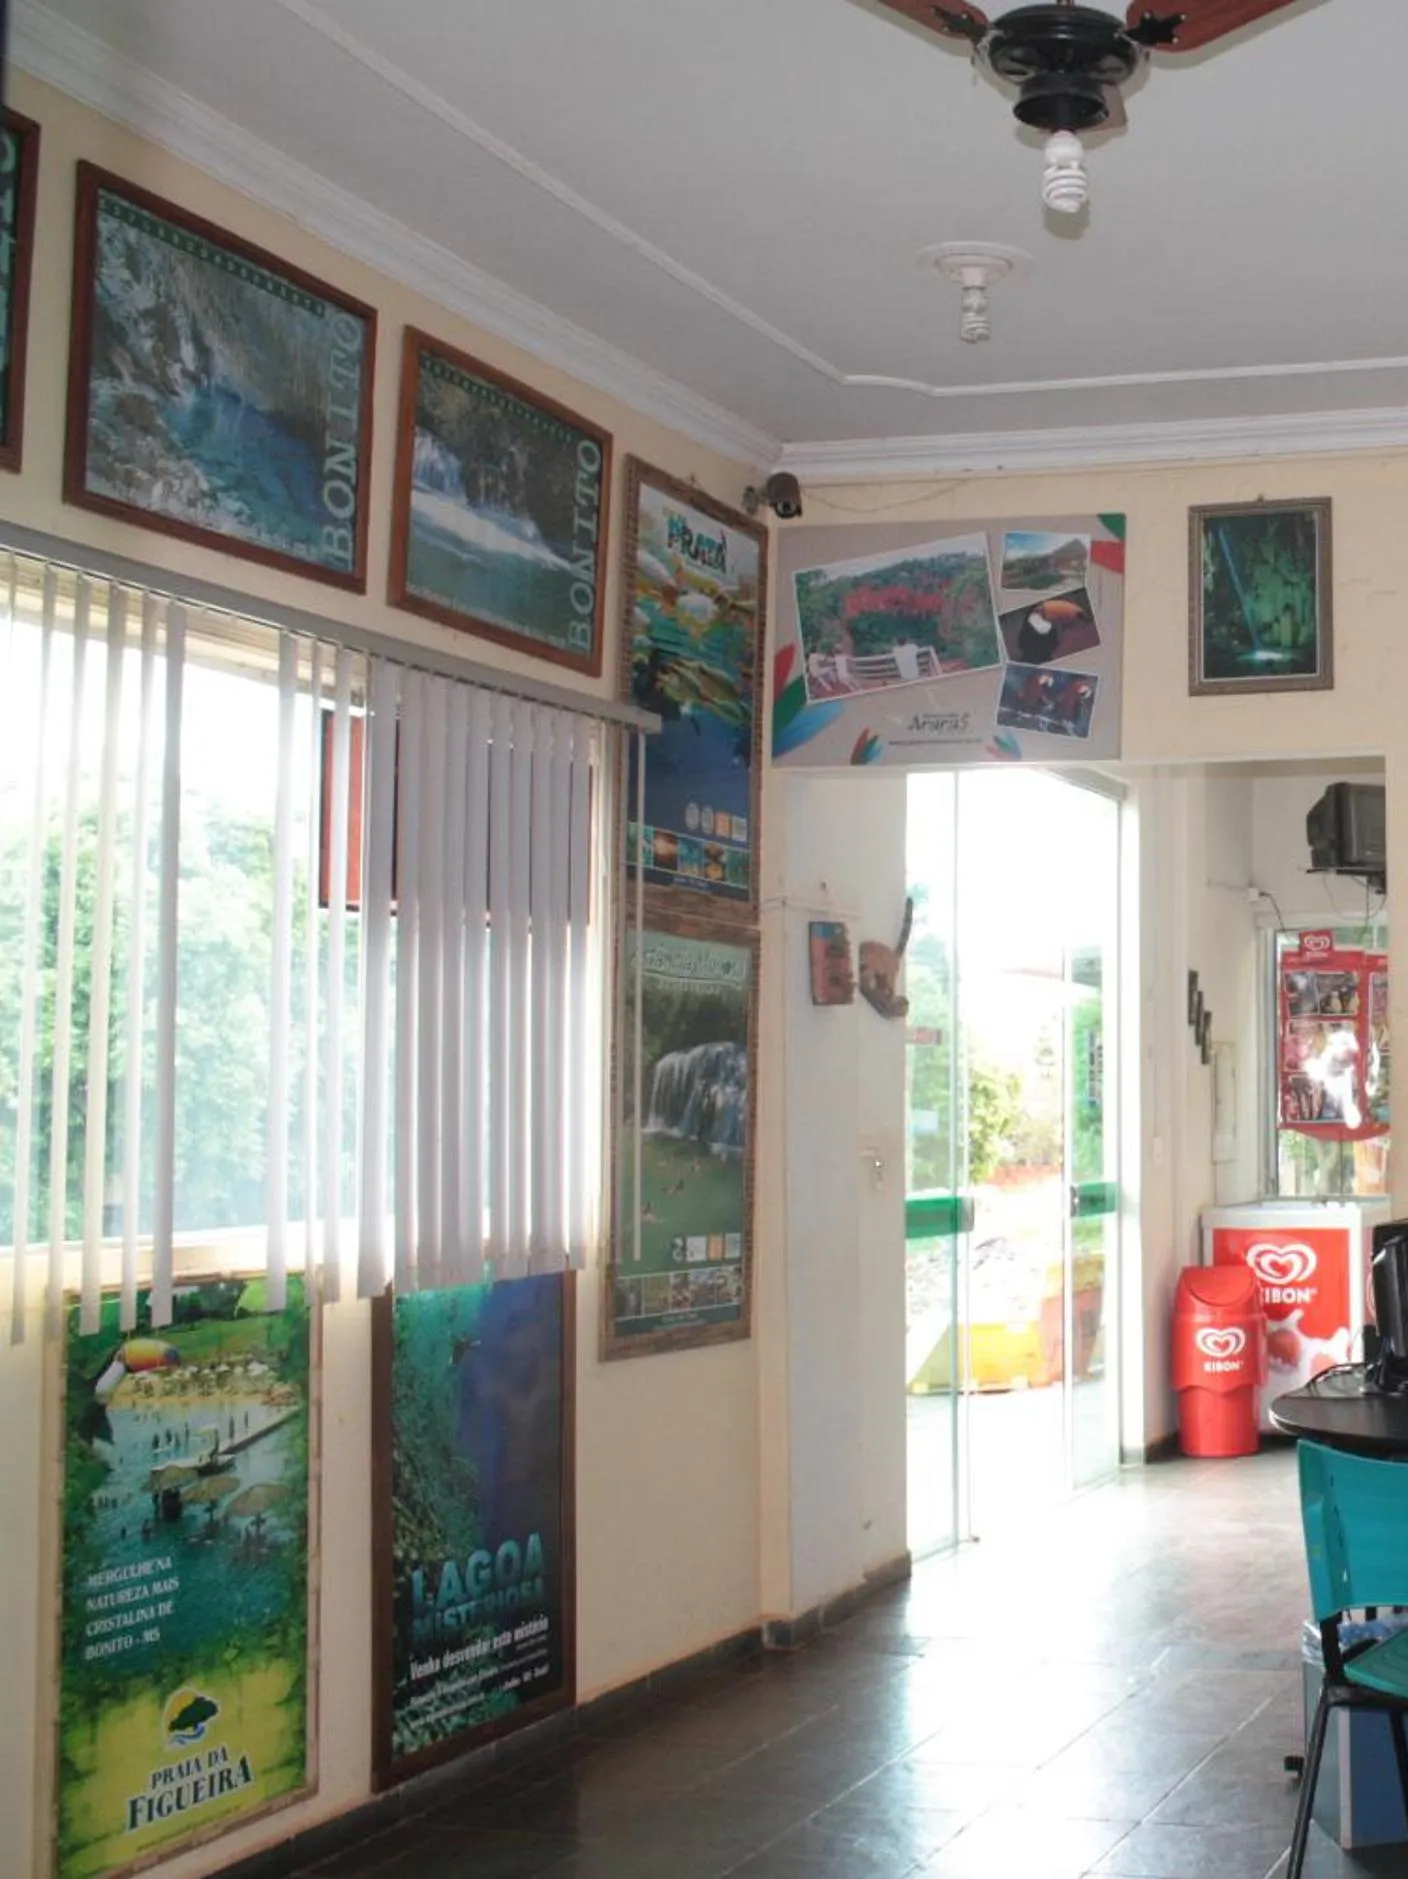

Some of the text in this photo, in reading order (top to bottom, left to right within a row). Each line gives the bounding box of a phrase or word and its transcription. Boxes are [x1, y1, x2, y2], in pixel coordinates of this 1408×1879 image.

[322, 309, 362, 573] BONITO
[568, 439, 601, 659] BONITO
[1264, 1287, 1312, 1304] IBON
[1203, 1361, 1241, 1373] KIBON
[410, 1532, 543, 1609] LAGOA
[85, 1577, 180, 1613] NATUREZA MAIS
[85, 1606, 156, 1637] CRISTALINA
[84, 1634, 133, 1661] BONITO
[151, 1745, 229, 1790] PRAIA DA
[126, 1755, 254, 1831] FIGUEIRA
